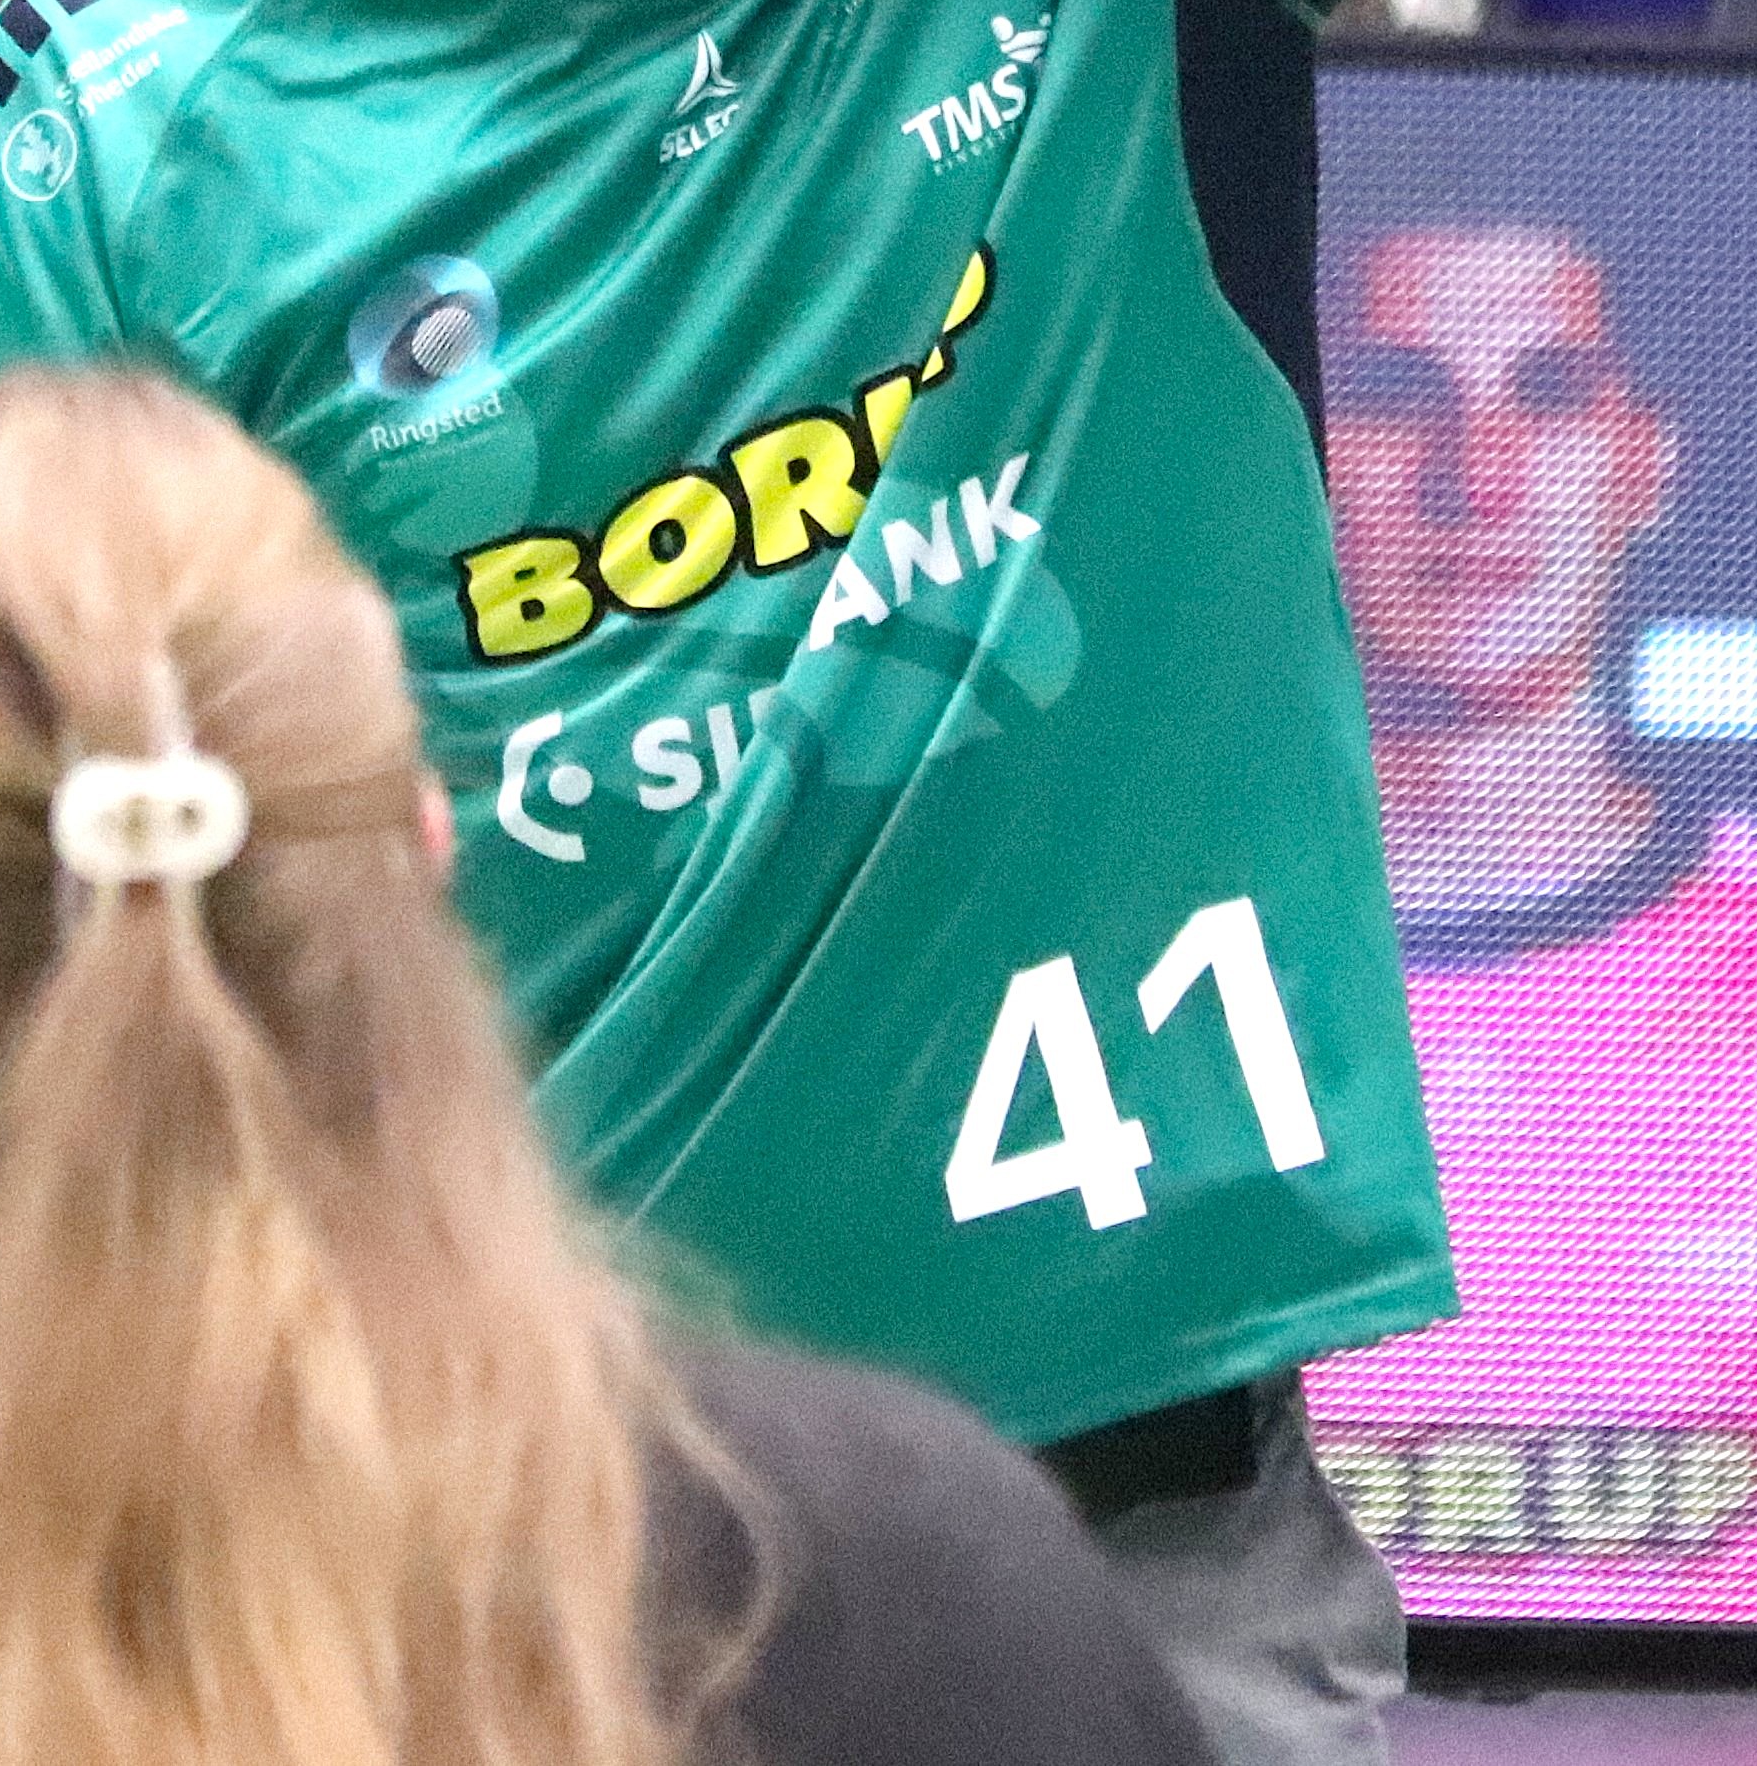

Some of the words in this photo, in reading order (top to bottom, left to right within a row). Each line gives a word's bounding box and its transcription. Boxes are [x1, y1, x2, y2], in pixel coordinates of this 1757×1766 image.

[79, 50, 162, 116] yheder
[901, 63, 1027, 161] TMS
[369, 388, 504, 451] Ringsted
[944, 895, 1327, 1231] 41
